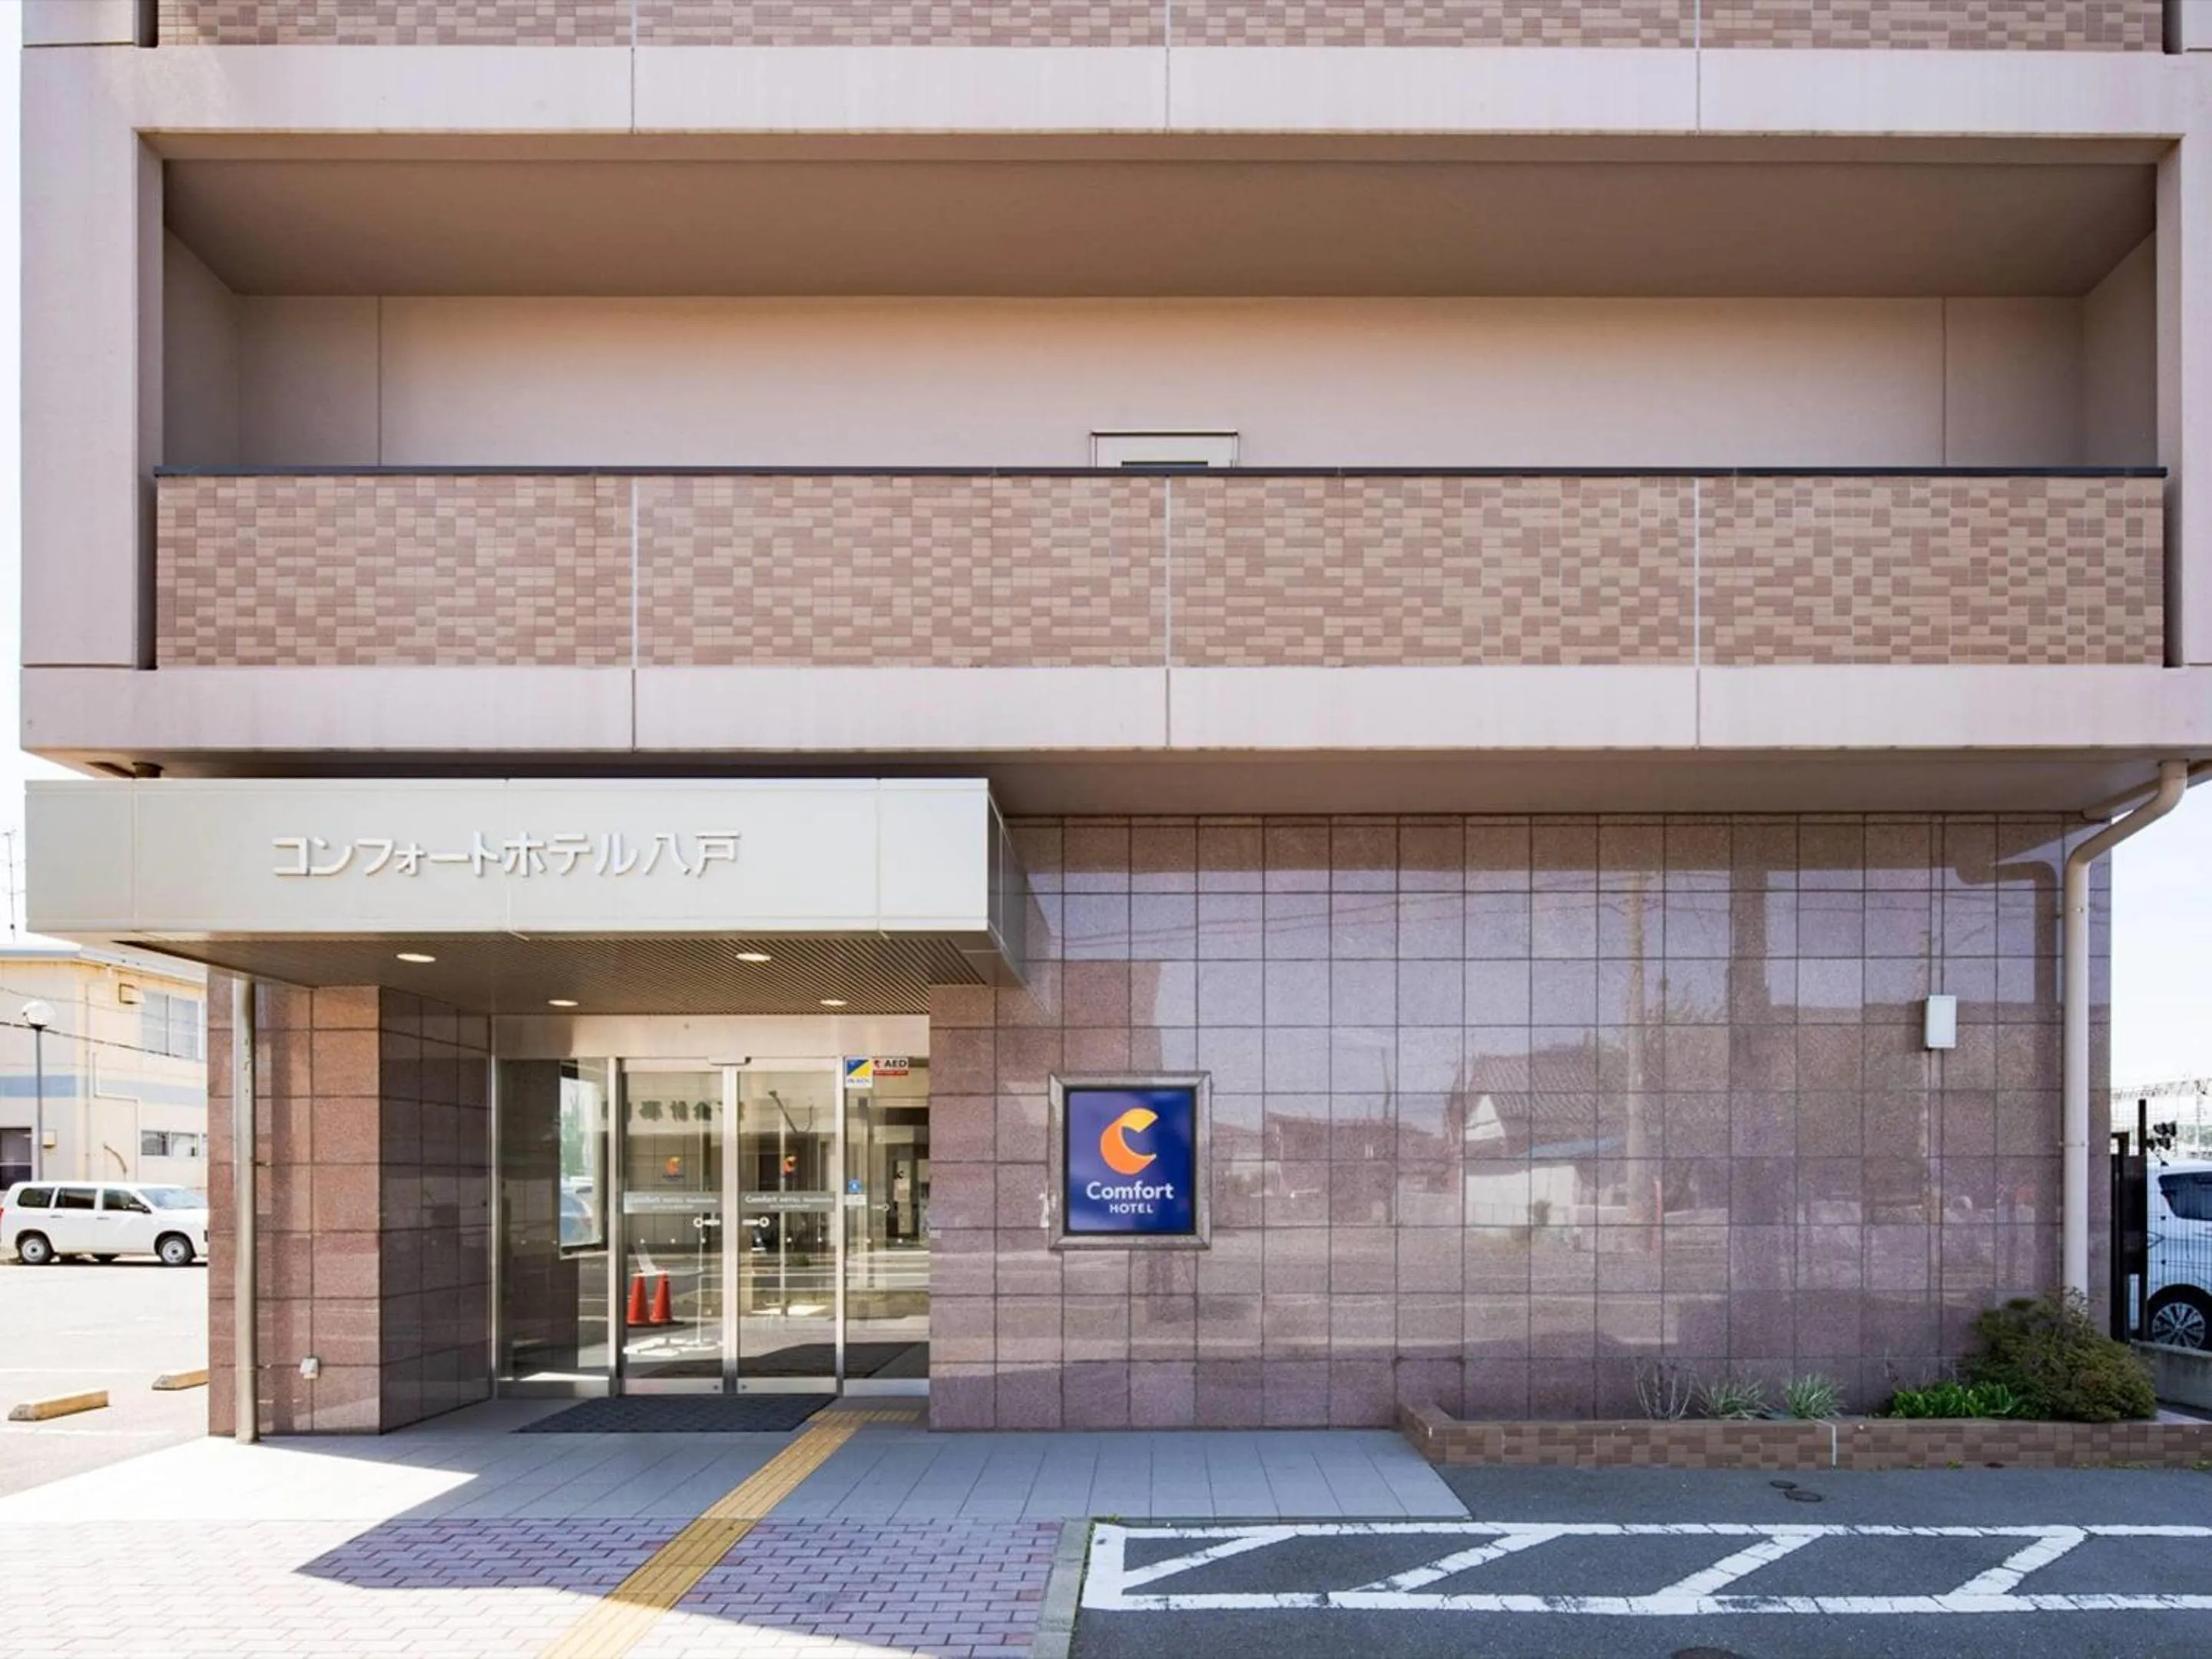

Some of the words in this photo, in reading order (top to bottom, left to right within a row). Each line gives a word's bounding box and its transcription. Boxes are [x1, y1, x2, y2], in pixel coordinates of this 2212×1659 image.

[273, 830, 741, 877] コンフォートホテル八戸
[884, 1059, 907, 1068] AED
[1086, 1181, 1174, 1200] Comfort
[1109, 1203, 1154, 1214] HOTEL
